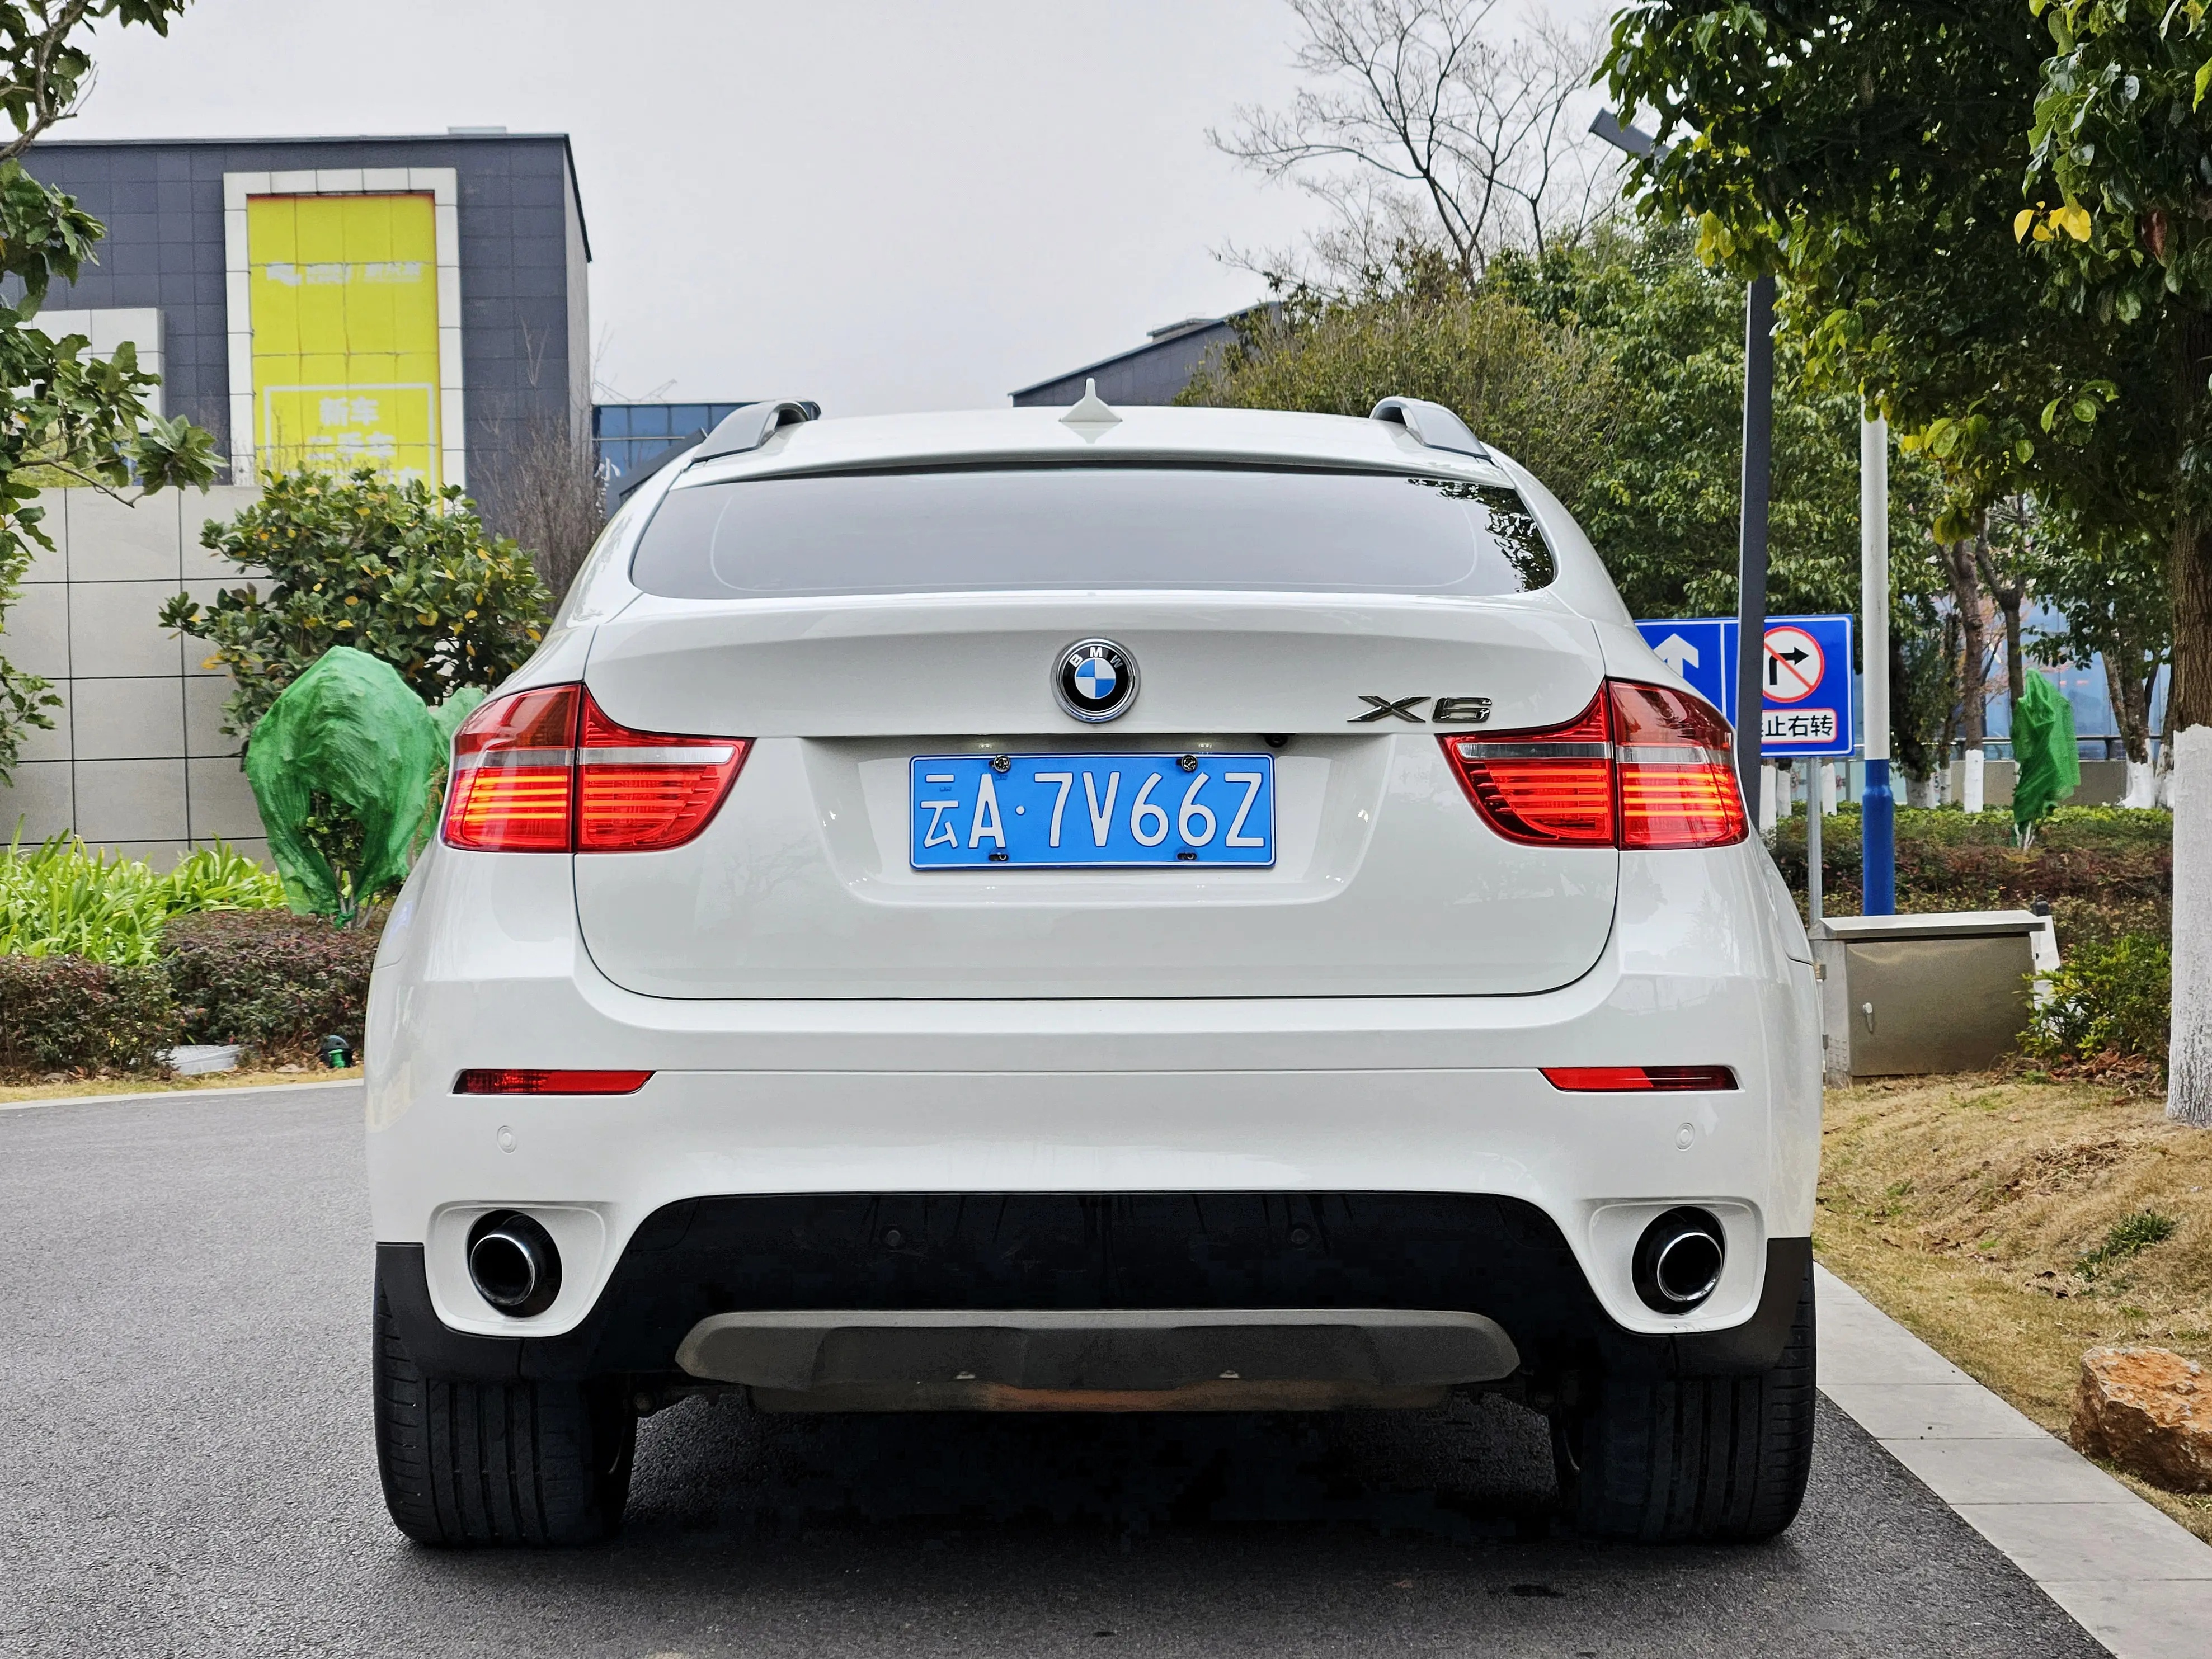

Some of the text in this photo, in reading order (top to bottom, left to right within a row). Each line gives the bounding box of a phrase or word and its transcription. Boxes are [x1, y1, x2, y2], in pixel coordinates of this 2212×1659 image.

[319, 395, 380, 426] 新车
[307, 431, 396, 462] 二手车
[1069, 646, 1124, 668] BMW
[1346, 695, 1493, 723] X6
[1761, 715, 1833, 737] 止右转
[920, 771, 1266, 849] 云A·7V66Z
